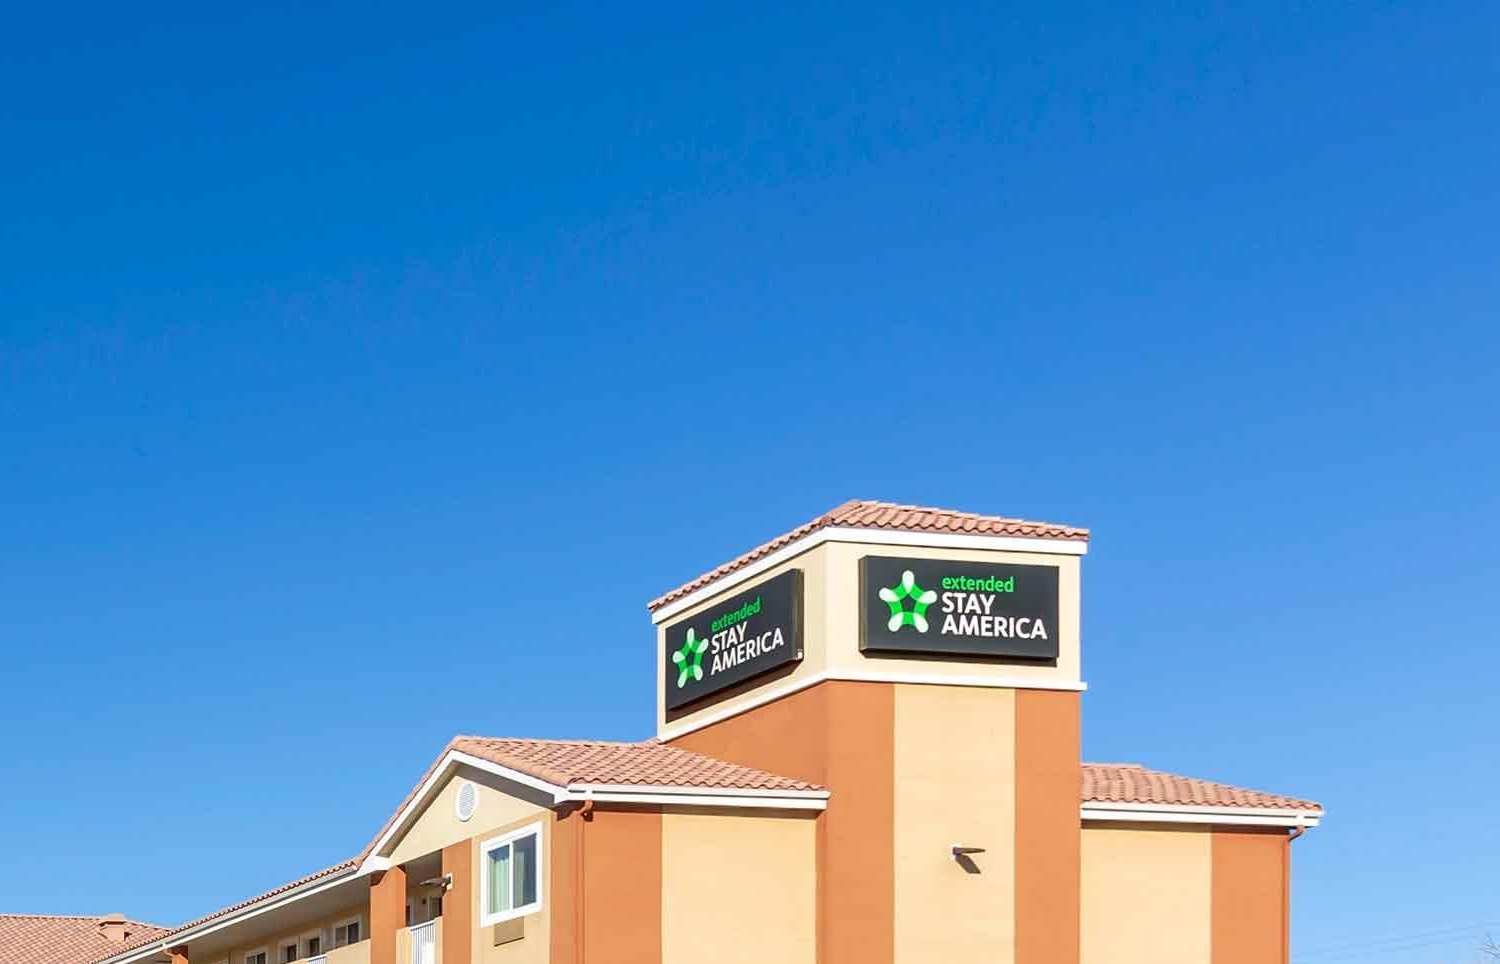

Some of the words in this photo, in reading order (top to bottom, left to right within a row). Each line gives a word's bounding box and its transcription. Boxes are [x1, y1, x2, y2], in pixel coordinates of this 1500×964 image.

[942, 575, 1014, 592] extended
[711, 595, 762, 632] extended
[941, 592, 996, 615] STAY
[711, 621, 748, 654] STAY
[941, 614, 1048, 640] AMERICA
[710, 627, 785, 676] AMERICA
